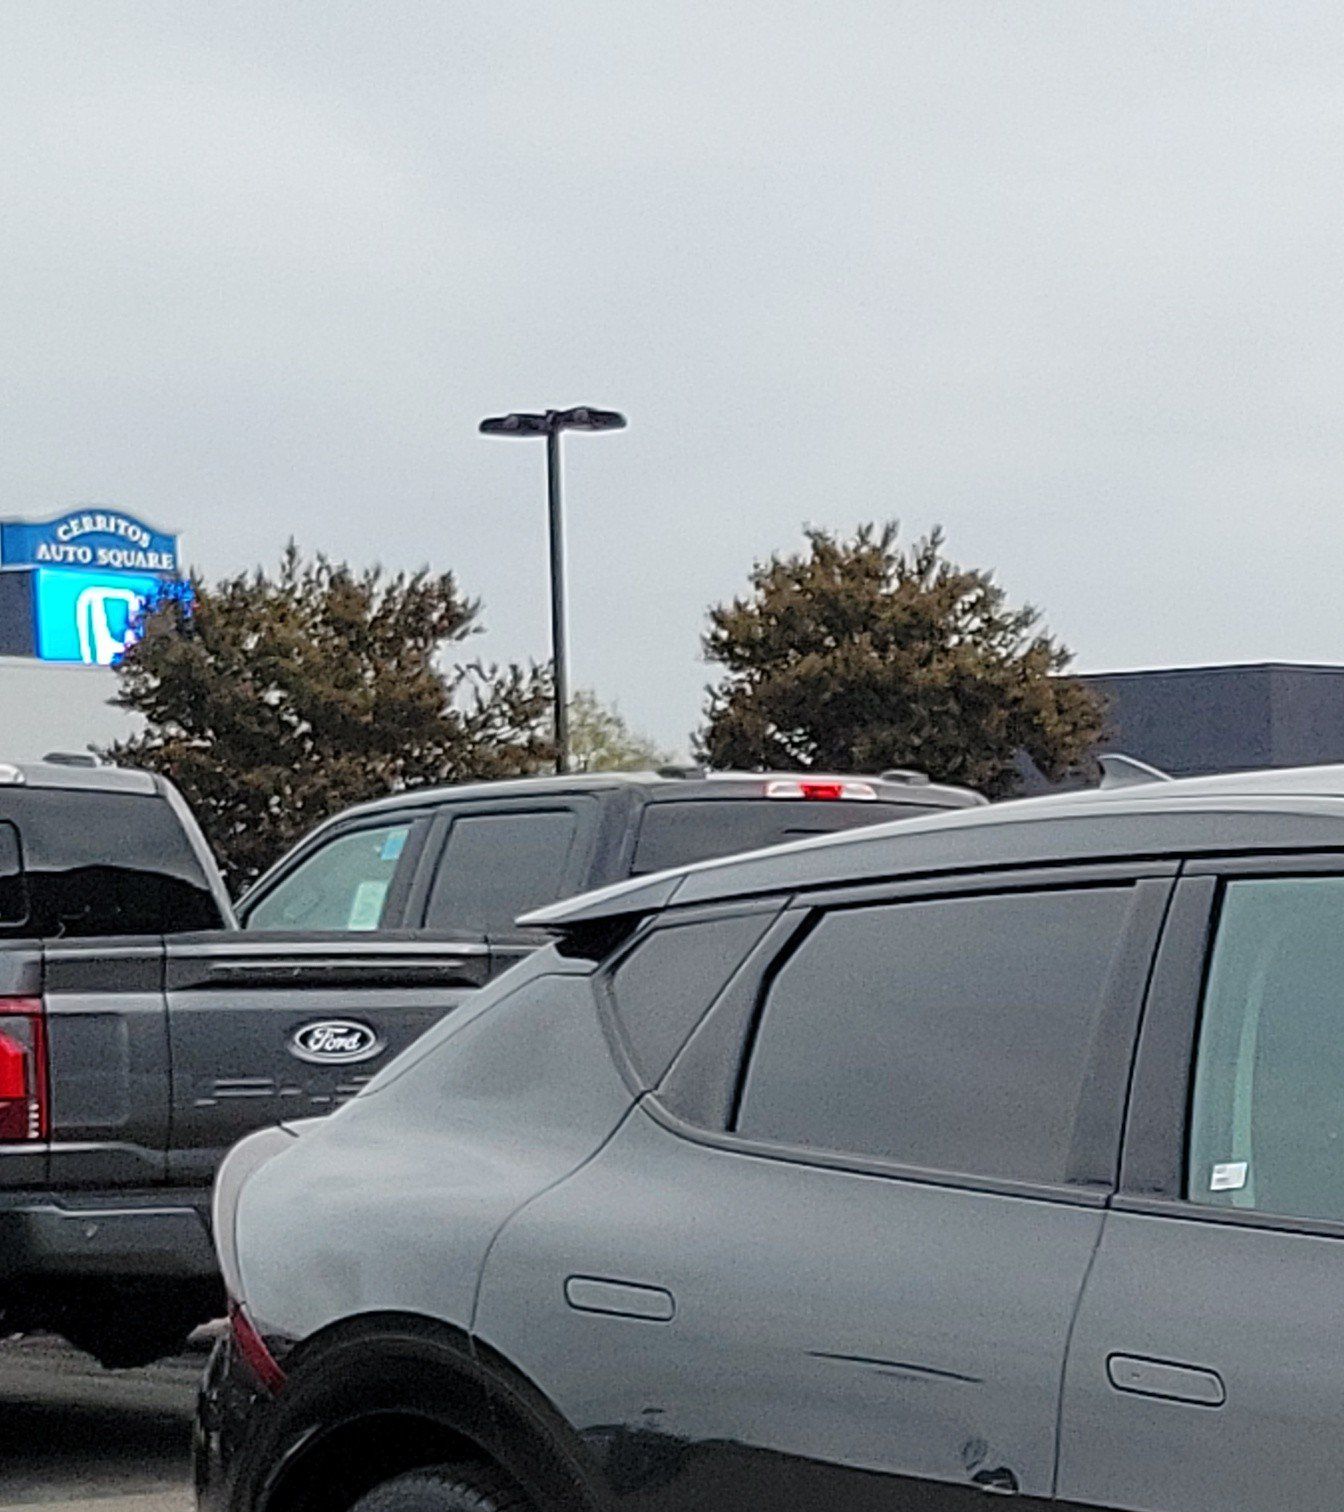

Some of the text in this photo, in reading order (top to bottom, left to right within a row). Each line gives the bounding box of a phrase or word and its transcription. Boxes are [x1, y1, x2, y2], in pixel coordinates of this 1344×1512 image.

[57, 514, 150, 548] CERRITOS
[37, 543, 174, 570] AUTO SQUARE
[308, 1026, 362, 1051] Ford
